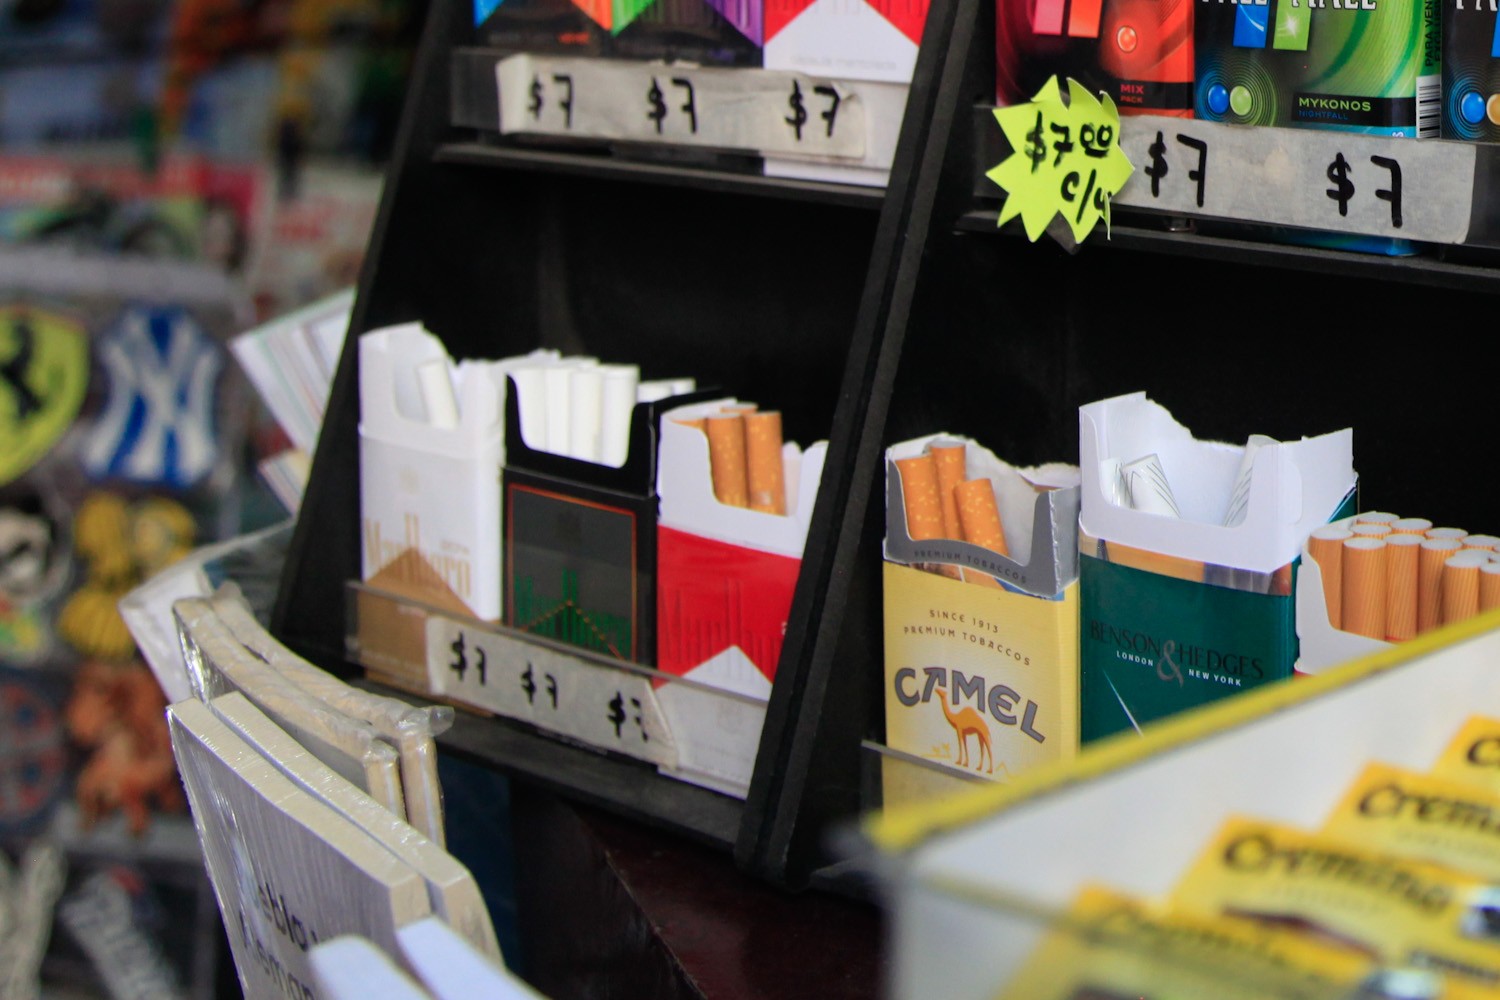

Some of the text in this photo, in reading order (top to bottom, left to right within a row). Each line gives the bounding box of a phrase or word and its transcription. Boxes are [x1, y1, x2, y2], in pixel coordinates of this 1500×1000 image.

[1424, 34, 1433, 67] PARA
[527, 73, 575, 128] $7
[646, 76, 698, 135] $7
[1121, 84, 1145, 94] MIX
[1299, 97, 1372, 112] MYKONOS
[784, 78, 843, 140] $7
[1299, 110, 1349, 121] NIGHTFALL
[1145, 131, 1208, 208] $7
[1326, 152, 1403, 228] $7
[914, 550, 1027, 584] PREMIUM TOBACCOS
[930, 609, 999, 634] SINCE 1913
[904, 626, 1031, 666] PREMIUM TOBACCOS
[1090, 619, 1161, 657] BENSON
[1179, 642, 1264, 680] HEDGES
[1116, 650, 1154, 667] LONDON
[1189, 668, 1242, 687] NEW YORK
[894, 667, 1046, 744] CAMEL
